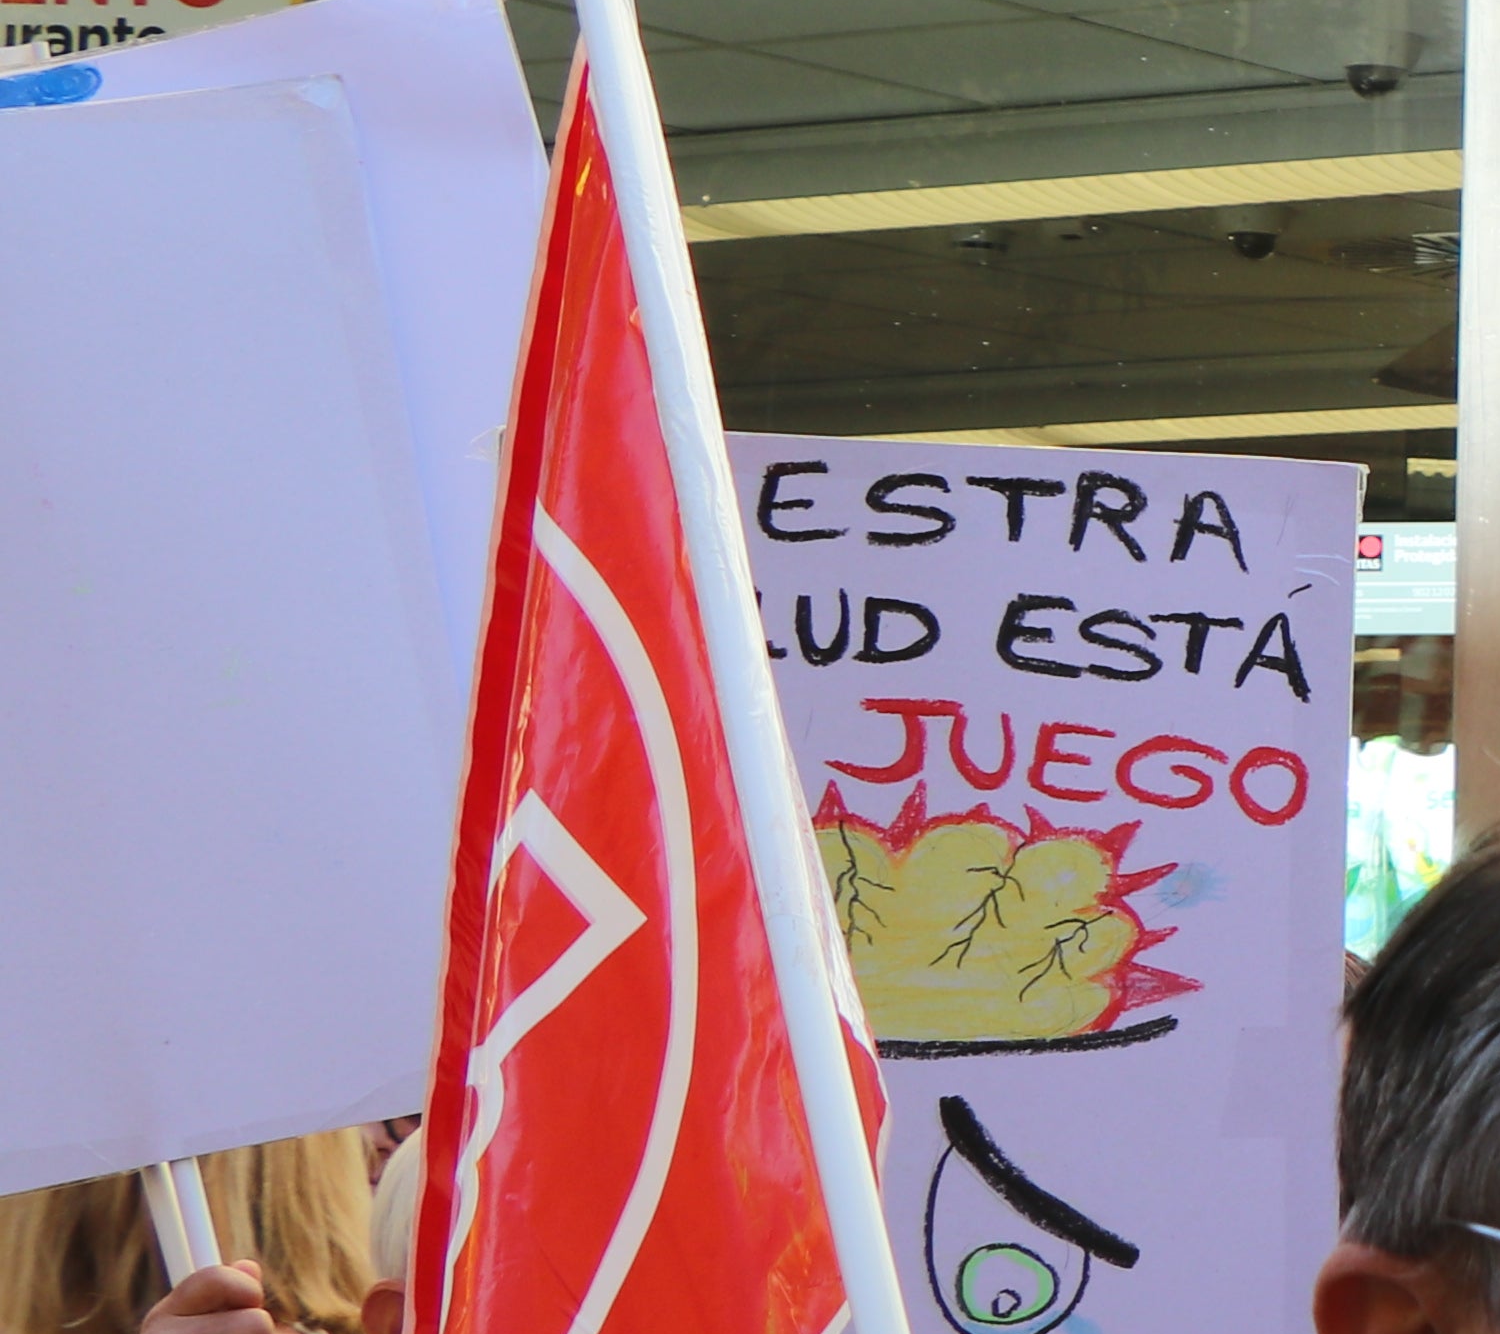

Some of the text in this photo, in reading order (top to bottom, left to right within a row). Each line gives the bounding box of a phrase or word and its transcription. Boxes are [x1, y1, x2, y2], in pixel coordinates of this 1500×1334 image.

[757, 460, 1248, 573] ESTRA
[996, 584, 1310, 703] ESTÁ
[824, 698, 1309, 827] JUEGO
